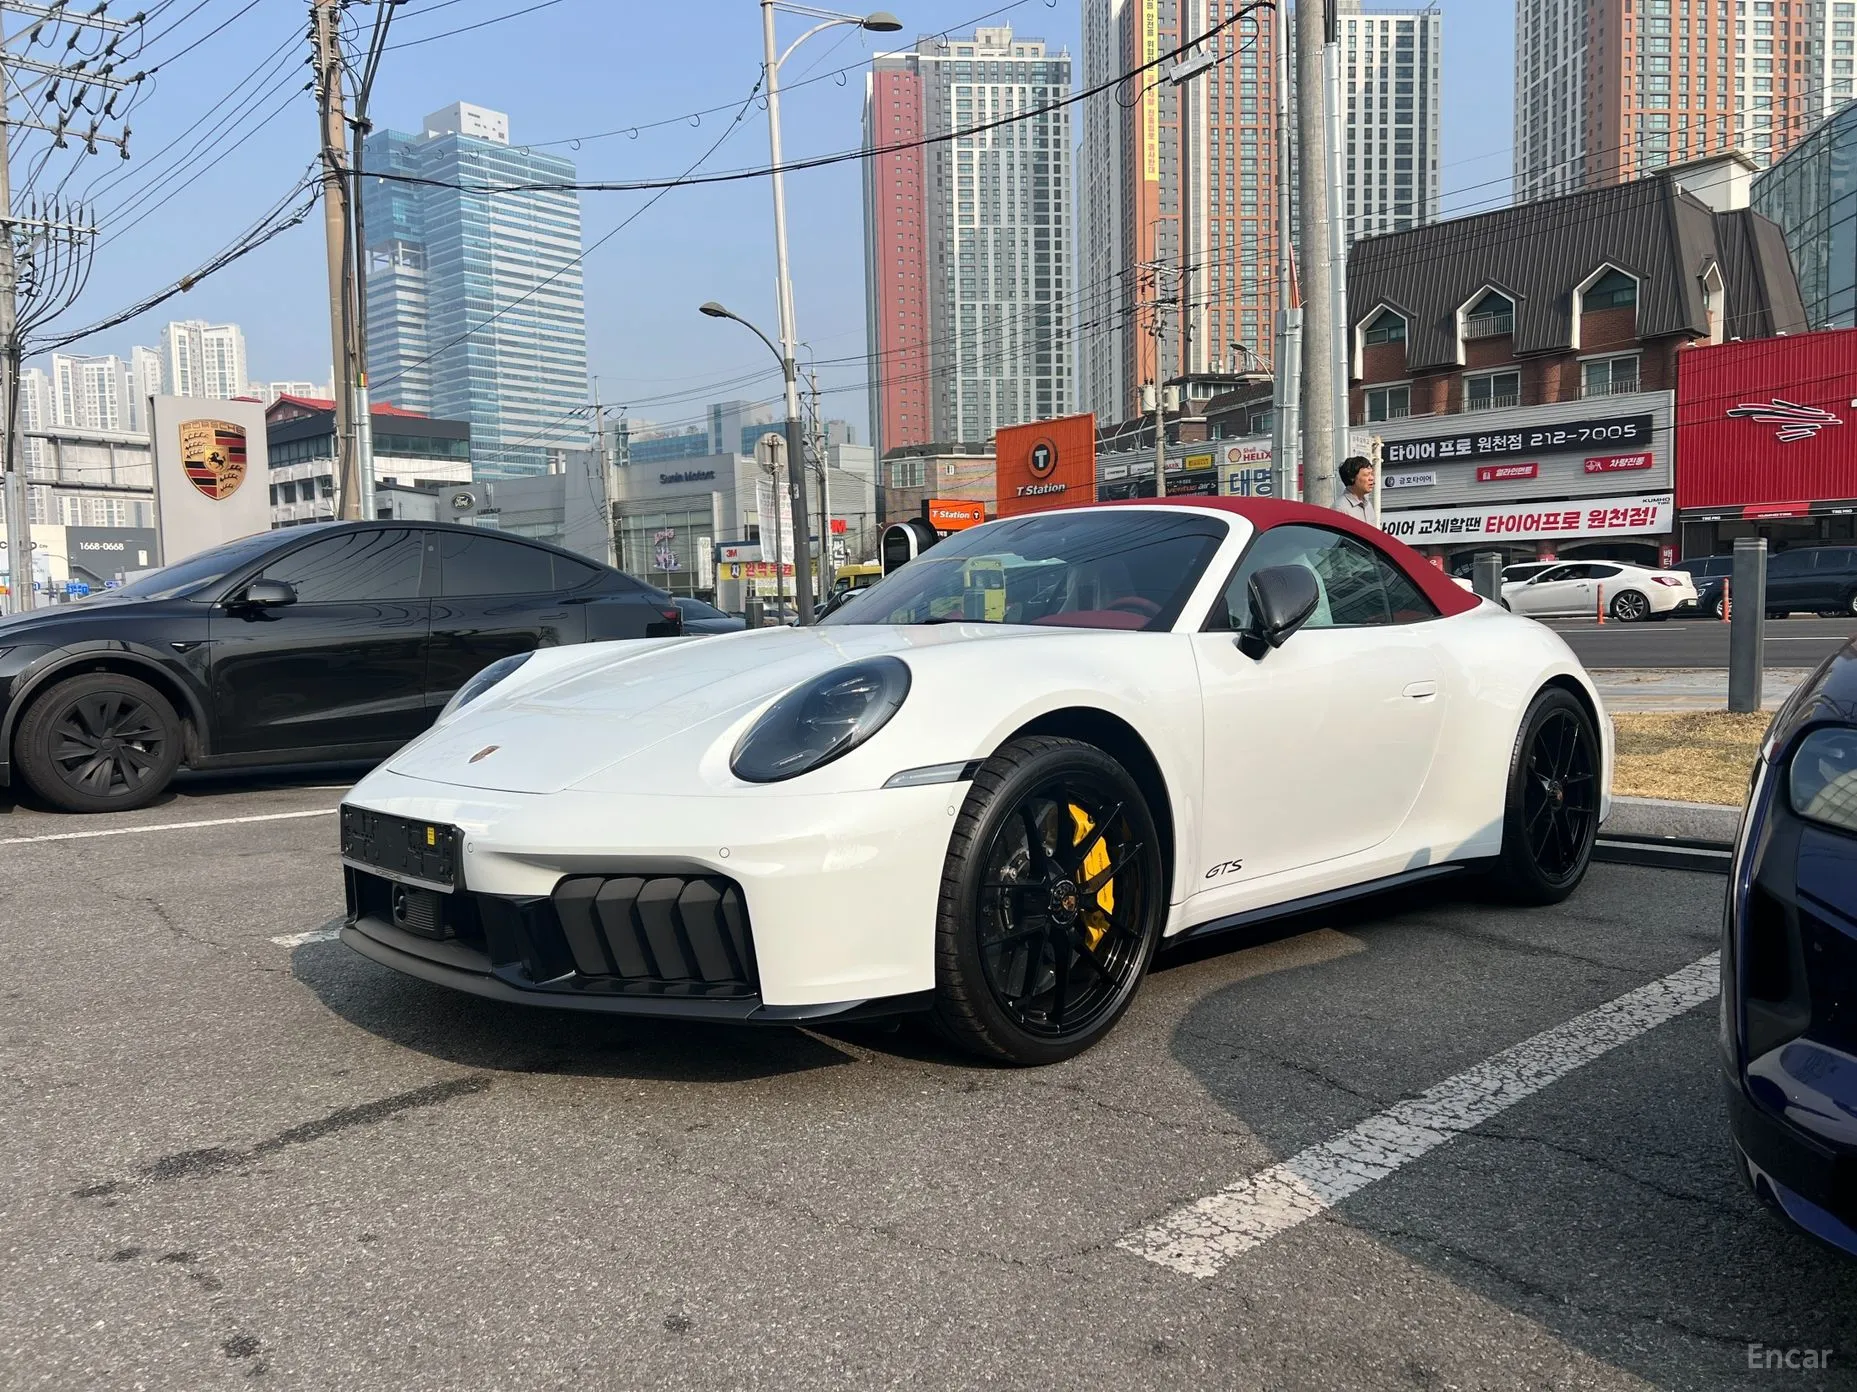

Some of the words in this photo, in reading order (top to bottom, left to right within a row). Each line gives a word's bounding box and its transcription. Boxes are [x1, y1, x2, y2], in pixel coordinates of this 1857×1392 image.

[1389, 441, 1435, 461] 타이어
[1439, 438, 1471, 457] 프로
[1477, 433, 1523, 453] 원천점
[1531, 423, 1637, 447] 212-7005
[1243, 446, 1257, 454] Shell
[1243, 452, 1272, 462] HELIX
[1399, 475, 1432, 485] 금호타이어
[1016, 486, 1025, 496] T
[1025, 483, 1066, 496] Station
[932, 510, 939, 518] T
[939, 510, 970, 519] Station
[1418, 516, 1482, 536] 교체할땐
[1484, 510, 1581, 534] 타이어프로
[1587, 506, 1657, 530] 원천점!
[79, 542, 125, 551] 1668-0668
[726, 549, 738, 558] 3M
[1205, 858, 1243, 879] GTS
